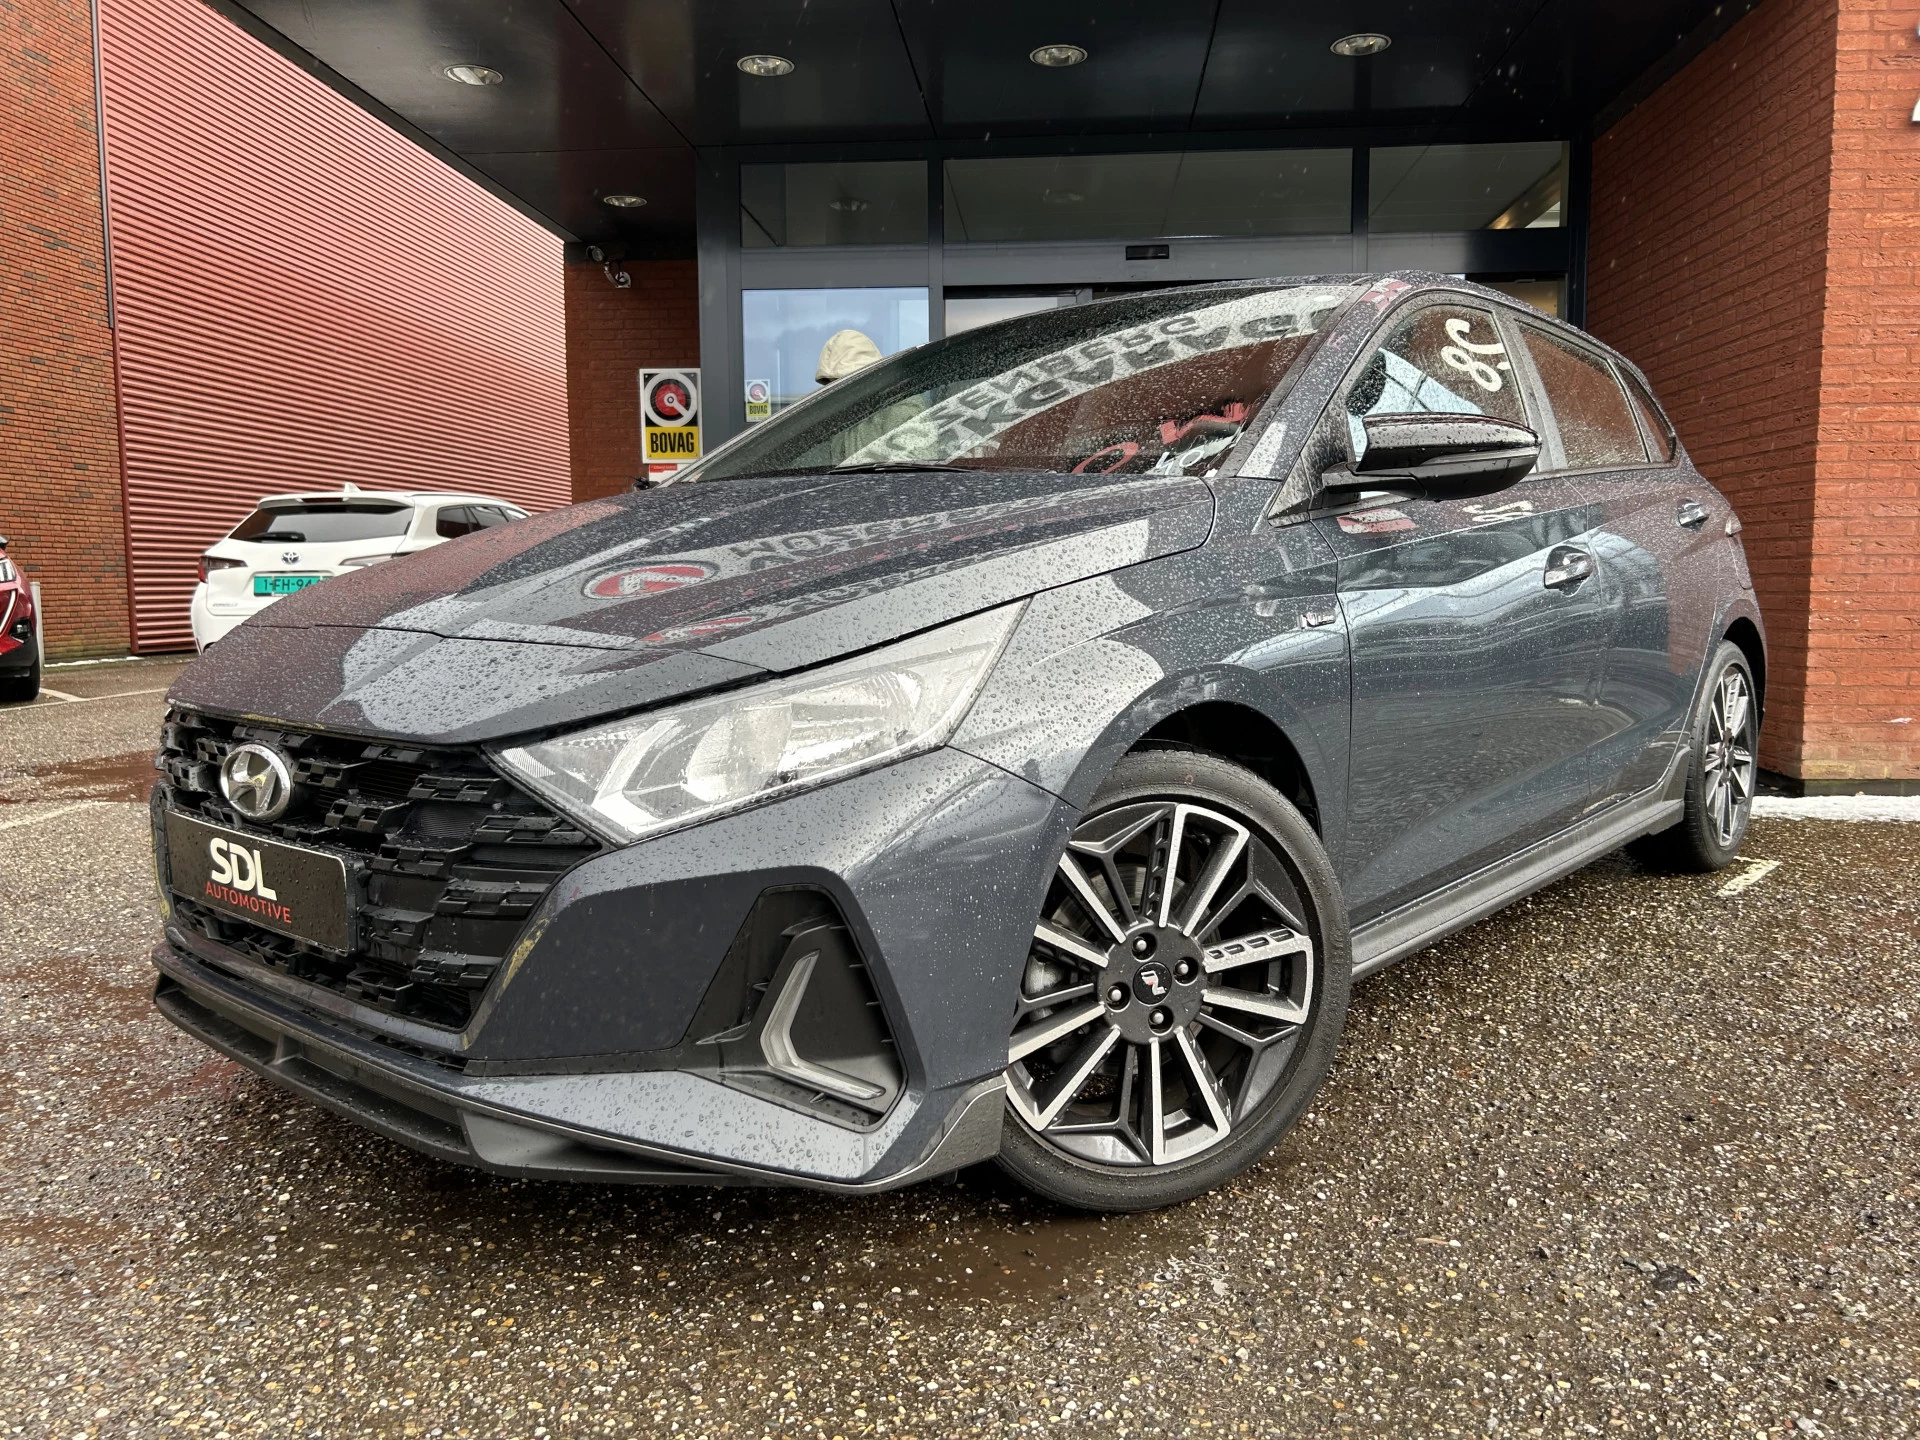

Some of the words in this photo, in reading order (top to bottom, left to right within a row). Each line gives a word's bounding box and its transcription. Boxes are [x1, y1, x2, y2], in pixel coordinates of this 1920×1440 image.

[749, 405, 768, 415] BOVAG
[650, 432, 695, 453] BOVAG
[210, 837, 277, 901] SDL
[206, 881, 292, 924] AUTOMOTIVE
